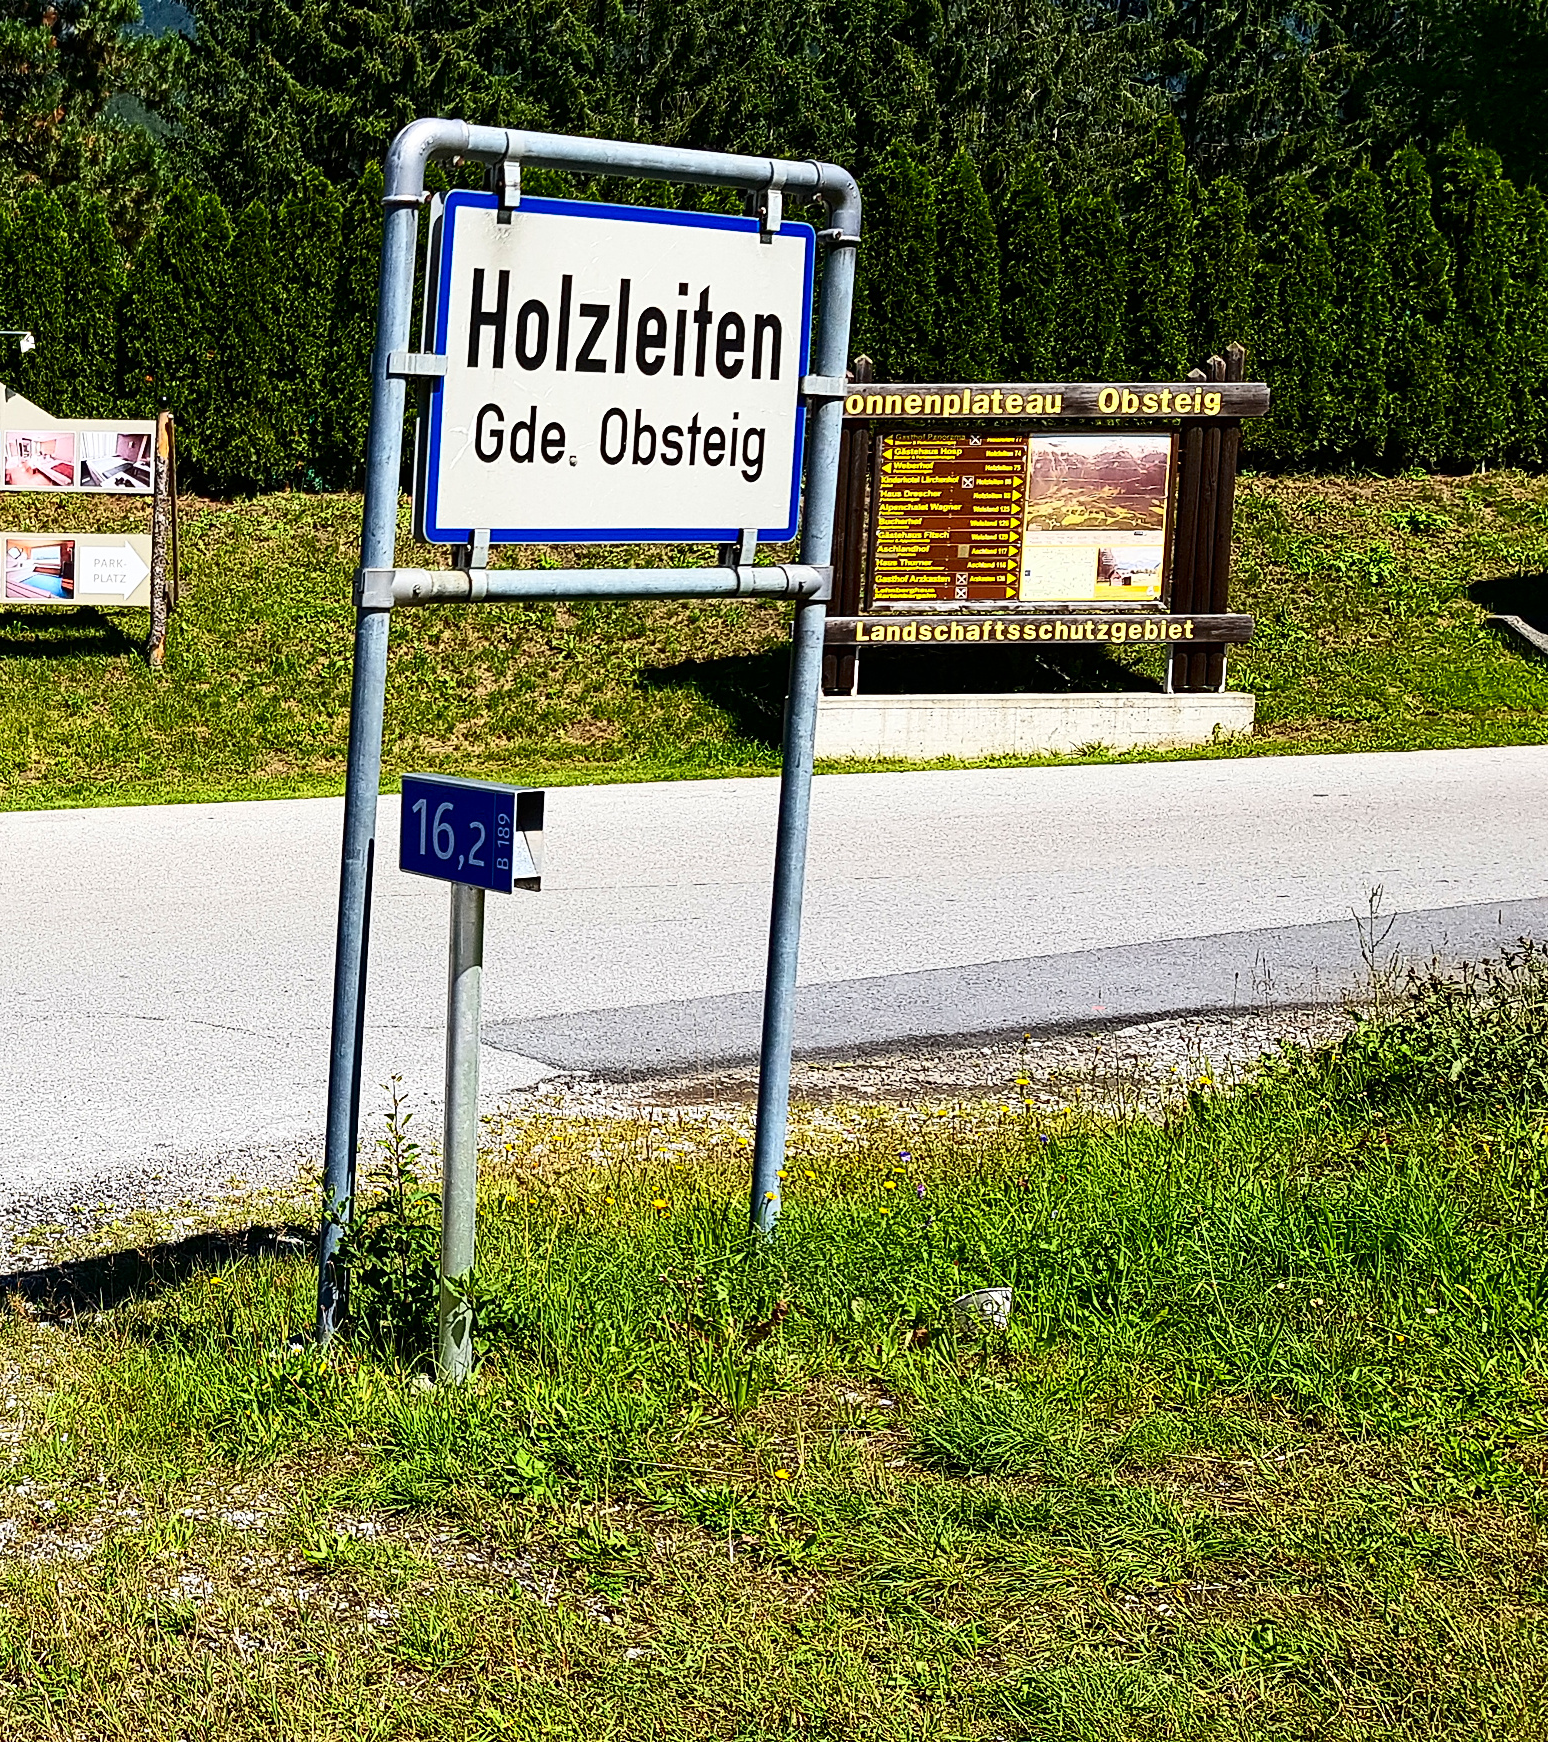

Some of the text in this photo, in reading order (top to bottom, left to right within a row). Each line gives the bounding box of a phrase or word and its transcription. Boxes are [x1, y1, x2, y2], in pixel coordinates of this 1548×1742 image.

[466, 267, 783, 381] Holzleiten
[845, 387, 1222, 418] onnenplateau Obsteig
[474, 403, 767, 483] Gde. Obsteig
[940, 448, 963, 457] Hosp
[930, 503, 963, 512] Wagner
[93, 558, 128, 568] PARK-
[93, 574, 127, 583] PLATZ
[856, 620, 1194, 643] Landschaftsschutzgebiet
[412, 799, 486, 871] 16,2
[496, 813, 511, 870] B 189
